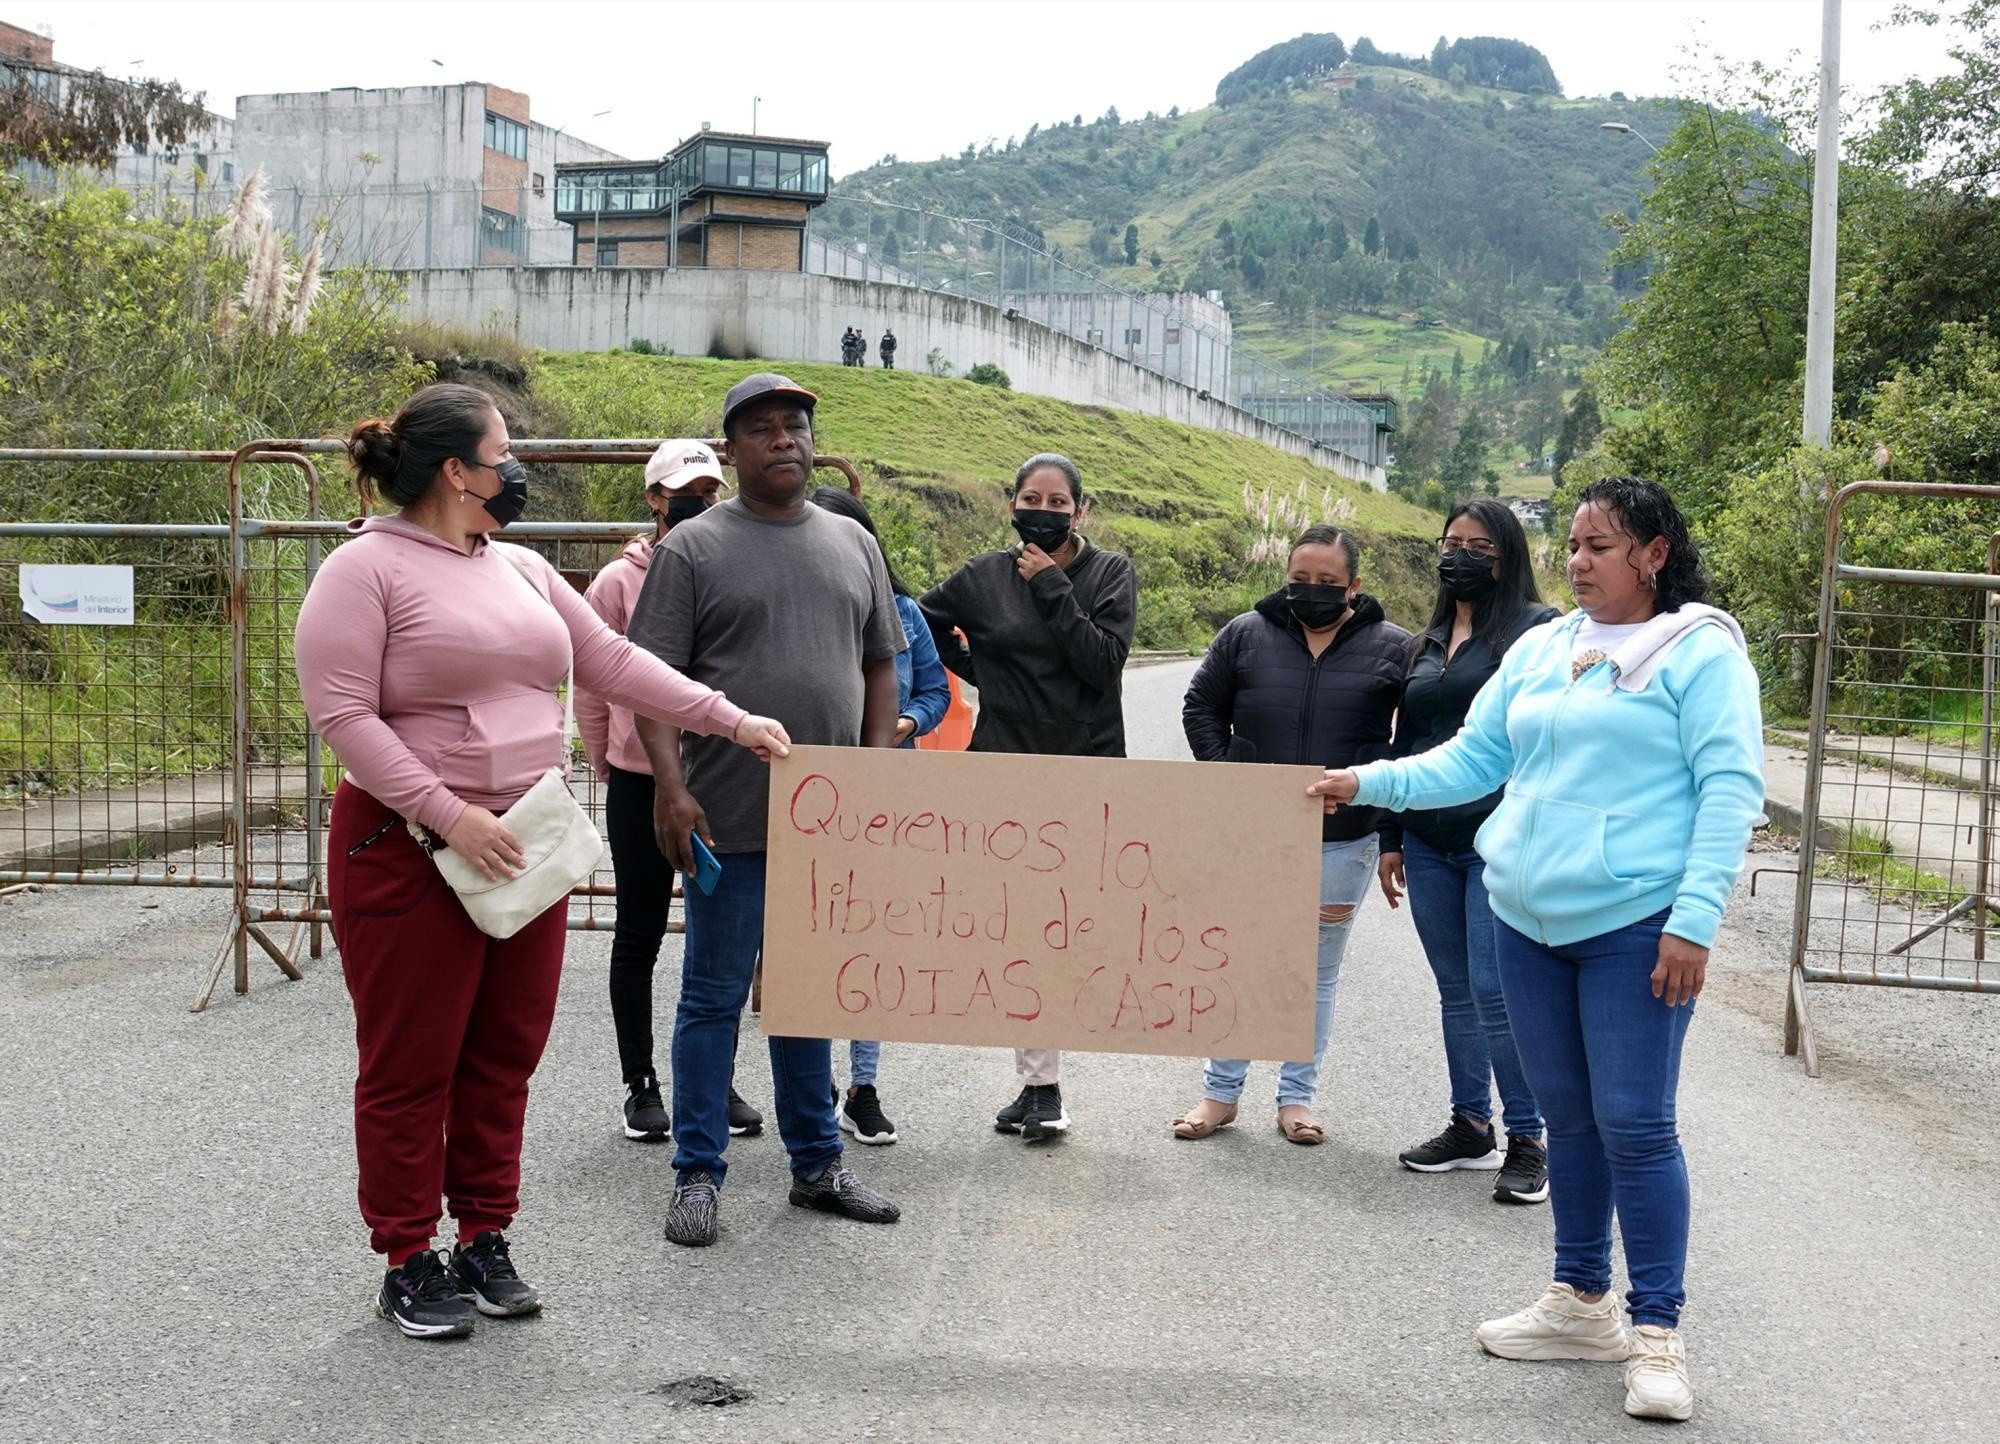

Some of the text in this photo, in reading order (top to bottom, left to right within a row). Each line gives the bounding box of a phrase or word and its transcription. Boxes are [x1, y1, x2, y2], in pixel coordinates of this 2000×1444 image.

[683, 455, 710, 465] PUMA
[84, 594, 122, 604] Ministerio
[97, 606, 128, 614] Interior
[790, 774, 1176, 898] Queremos la
[811, 858, 1231, 971] libertad de los
[836, 953, 1238, 1045] GUIAS (ASP)
